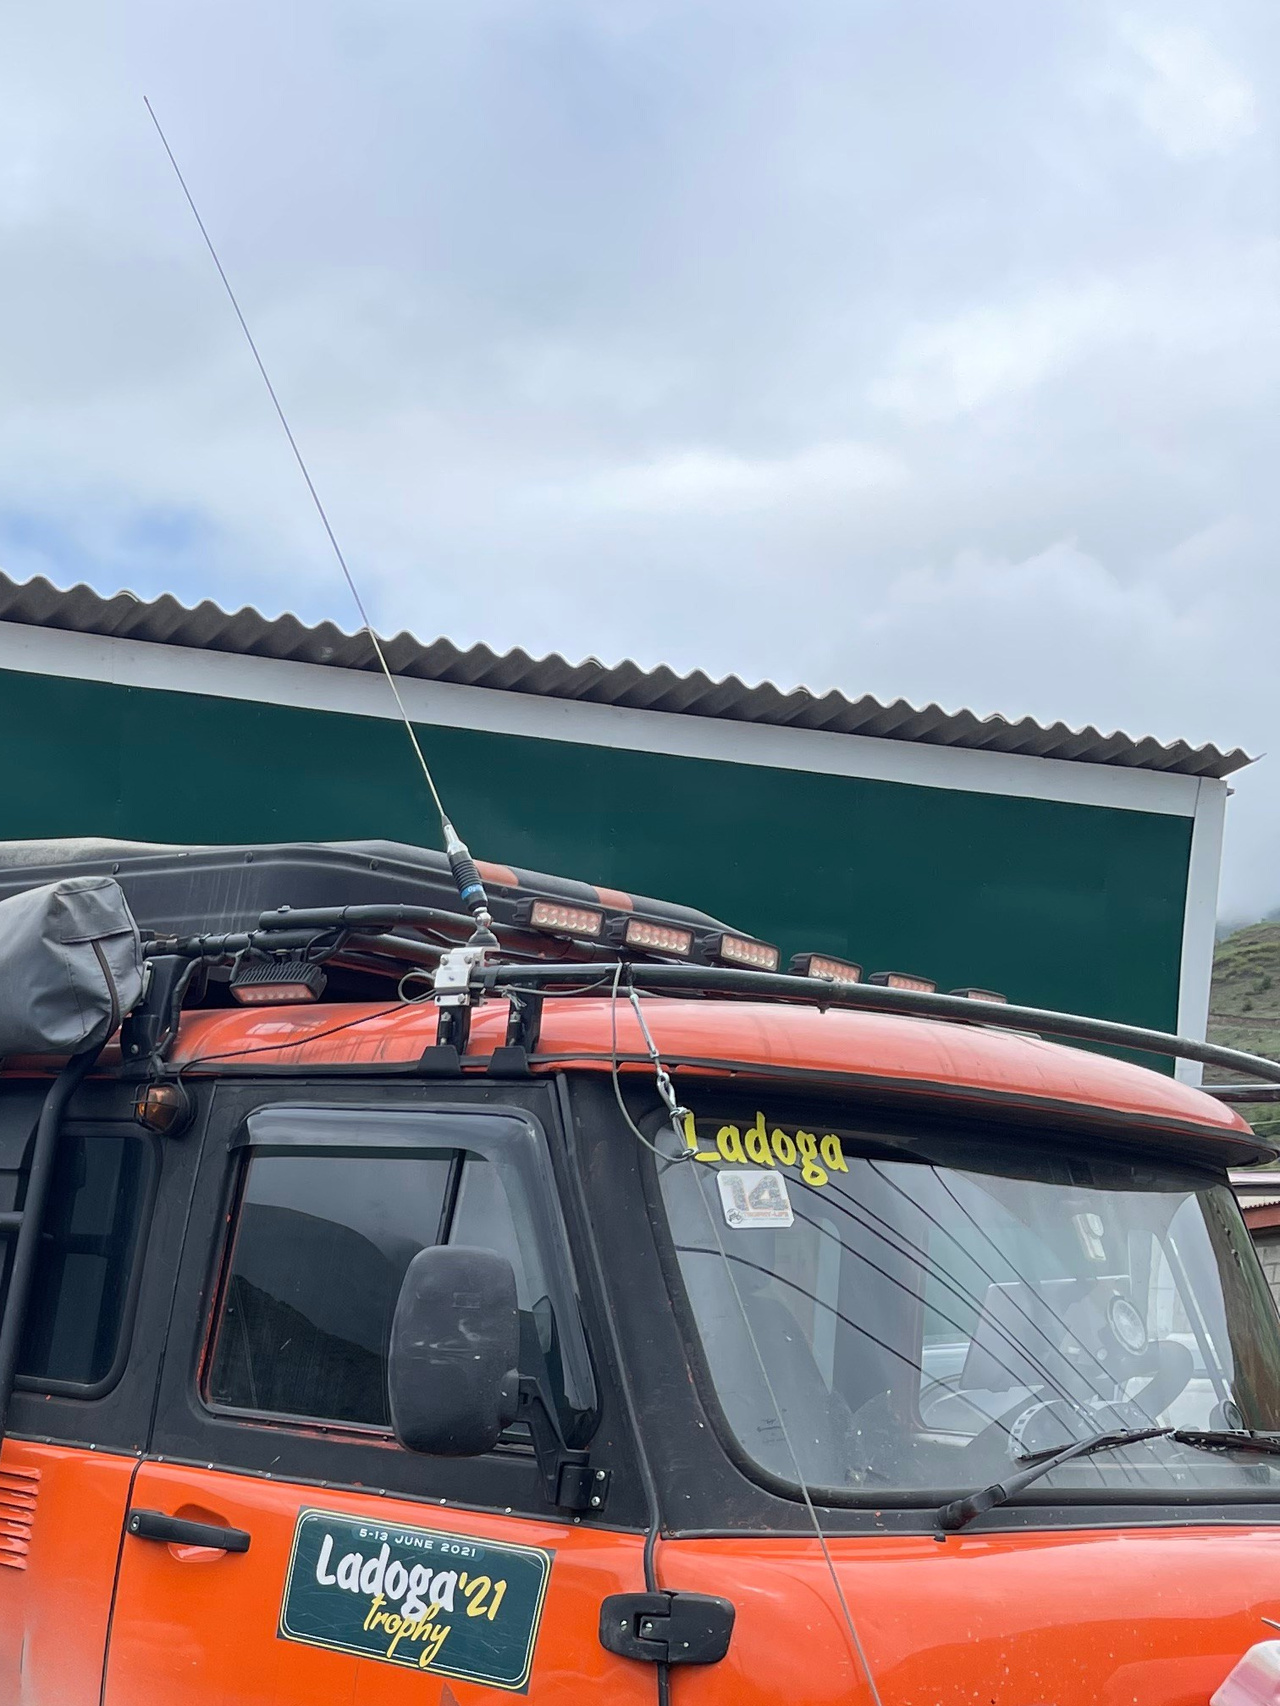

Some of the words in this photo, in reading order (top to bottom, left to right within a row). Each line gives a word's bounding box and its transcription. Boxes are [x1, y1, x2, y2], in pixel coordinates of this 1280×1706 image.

[683, 1110, 849, 1186] Ladoga
[720, 1174, 789, 1211] 14
[359, 1528, 389, 1542] 5-13
[394, 1535, 434, 1550] JUNE
[440, 1543, 476, 1558] 2021
